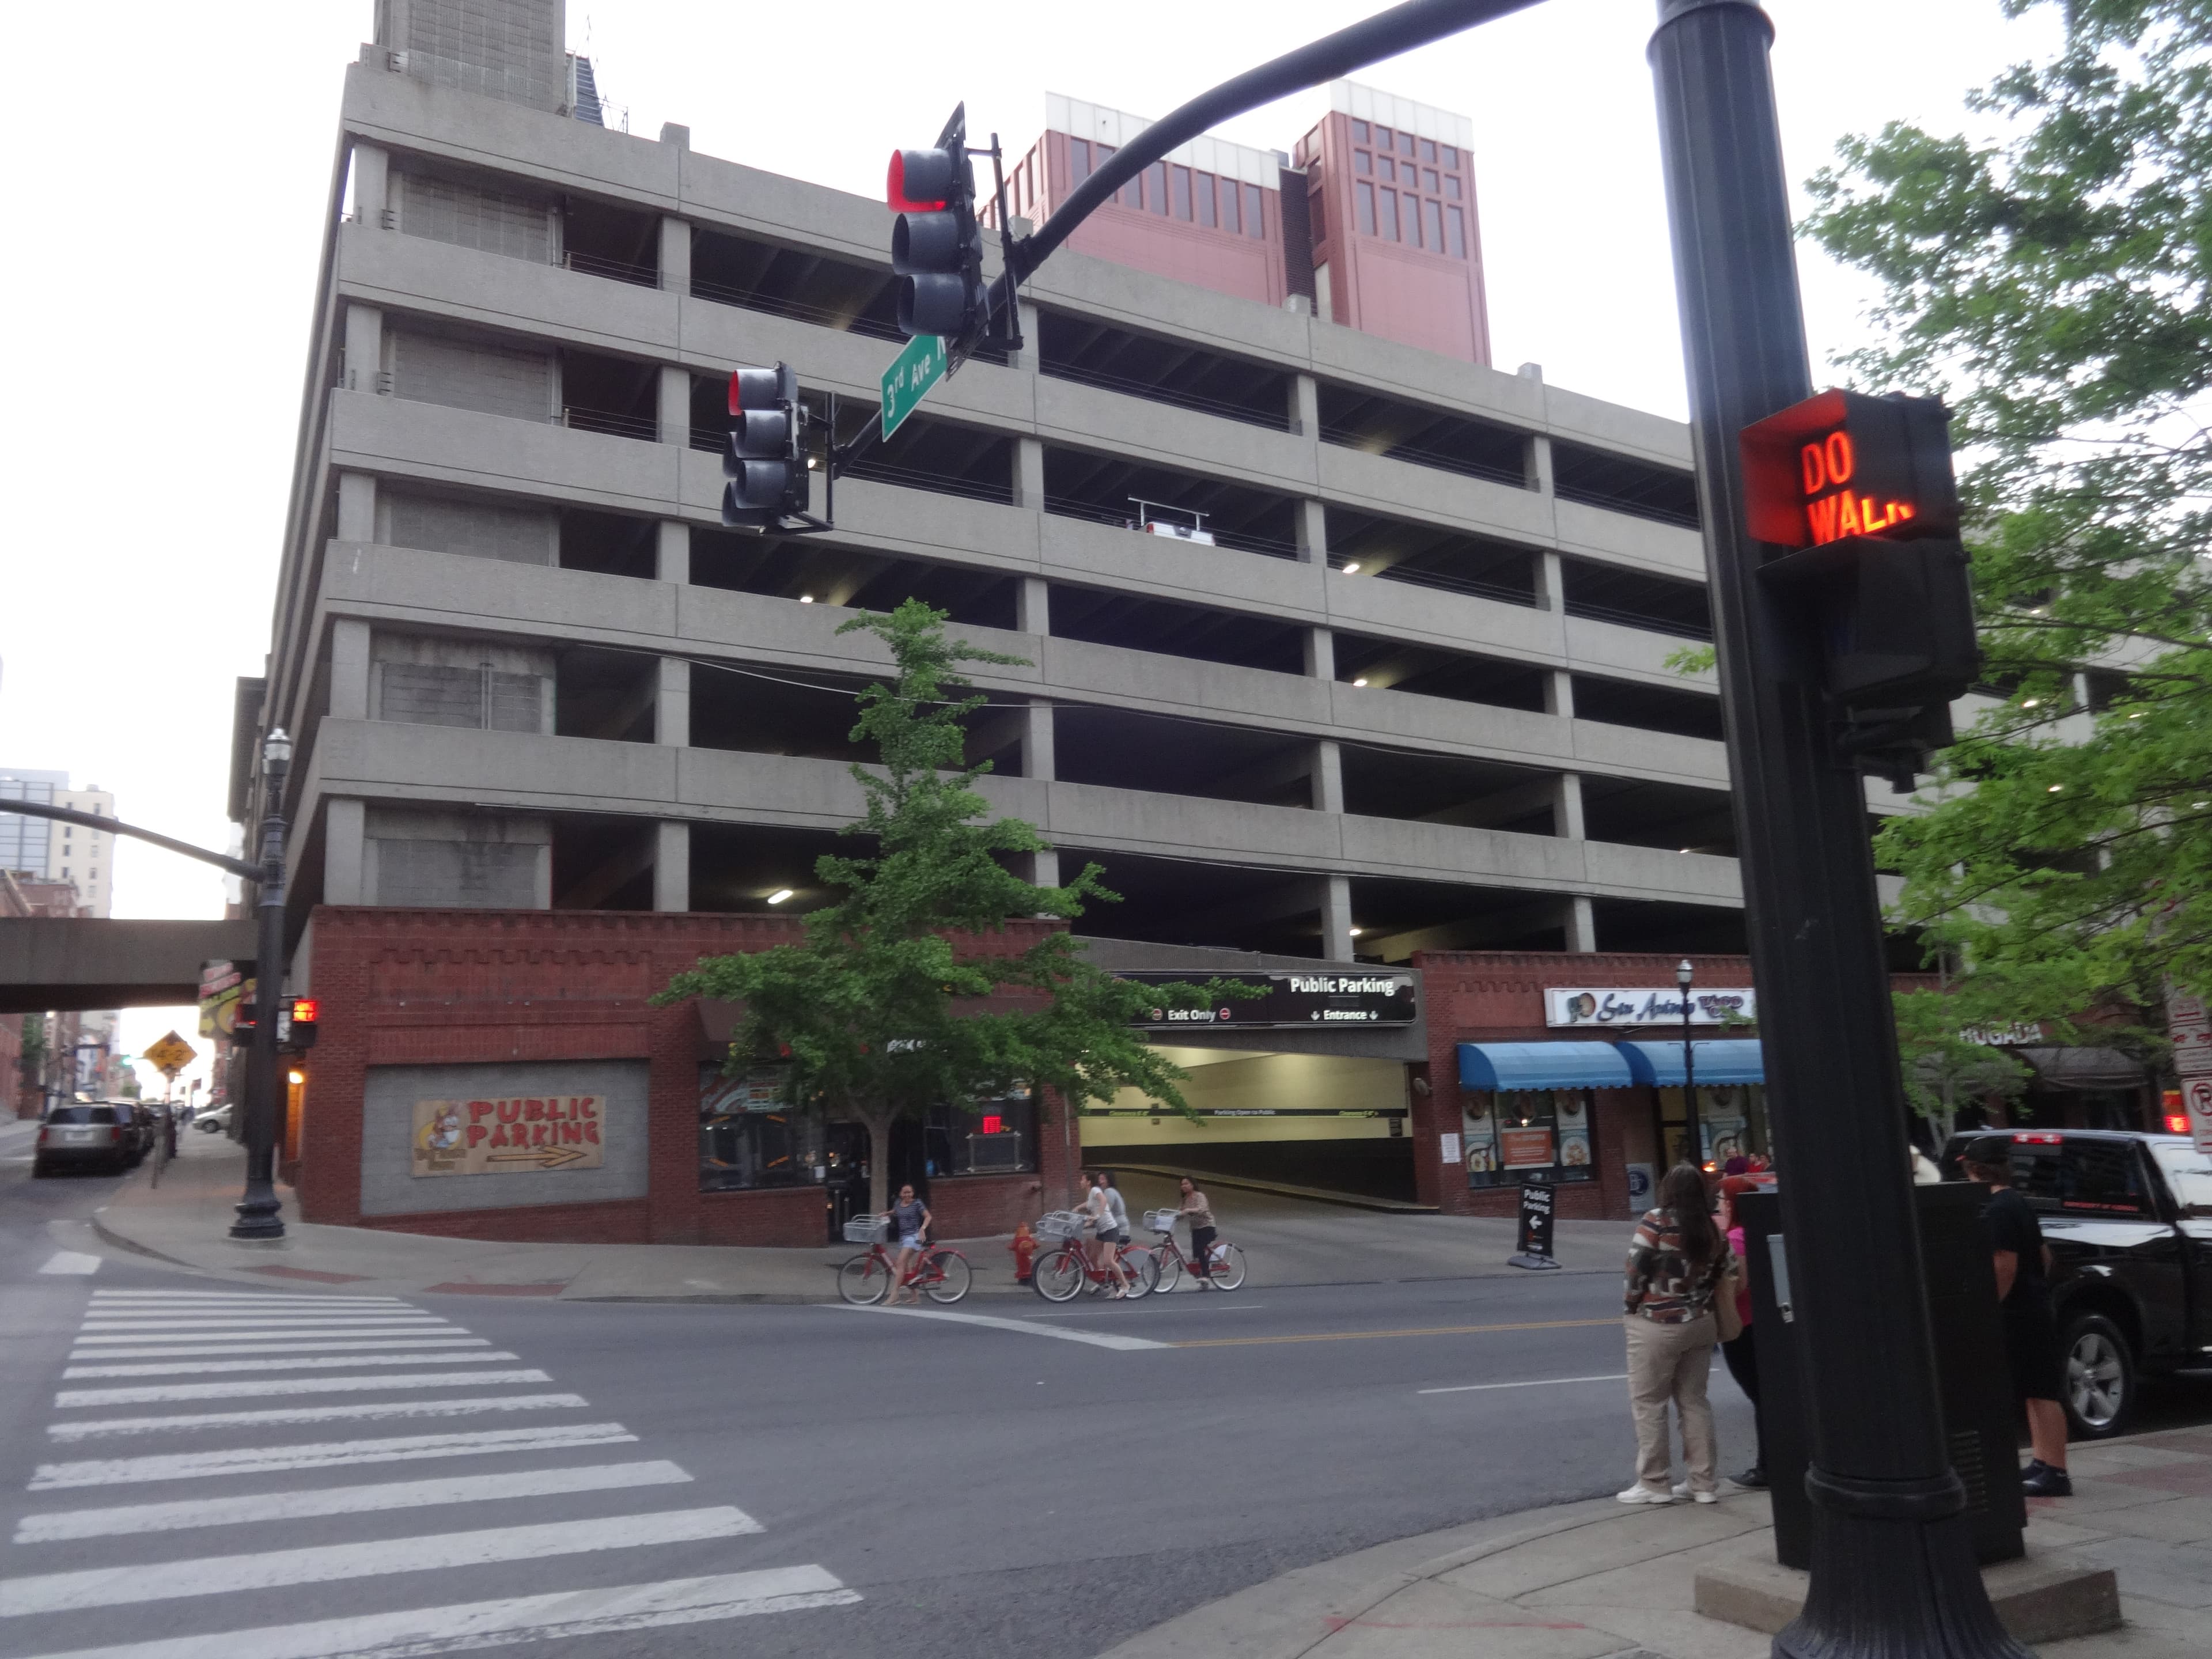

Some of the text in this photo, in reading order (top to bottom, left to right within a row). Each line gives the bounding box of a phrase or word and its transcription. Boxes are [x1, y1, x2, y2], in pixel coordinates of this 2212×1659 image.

[887, 366, 904, 418] 3rd
[911, 354, 931, 392] Ave
[1290, 978, 1395, 997] Public Parking
[1168, 1009, 1216, 1022] Exit Only
[1323, 1010, 1368, 1020] Entrance
[1637, 993, 1695, 1021] Antono
[467, 1097, 597, 1123] PUBLIC
[466, 1121, 600, 1149] PARKING
[1524, 1189, 1551, 1202] Public
[1523, 1201, 1551, 1215] Parking
